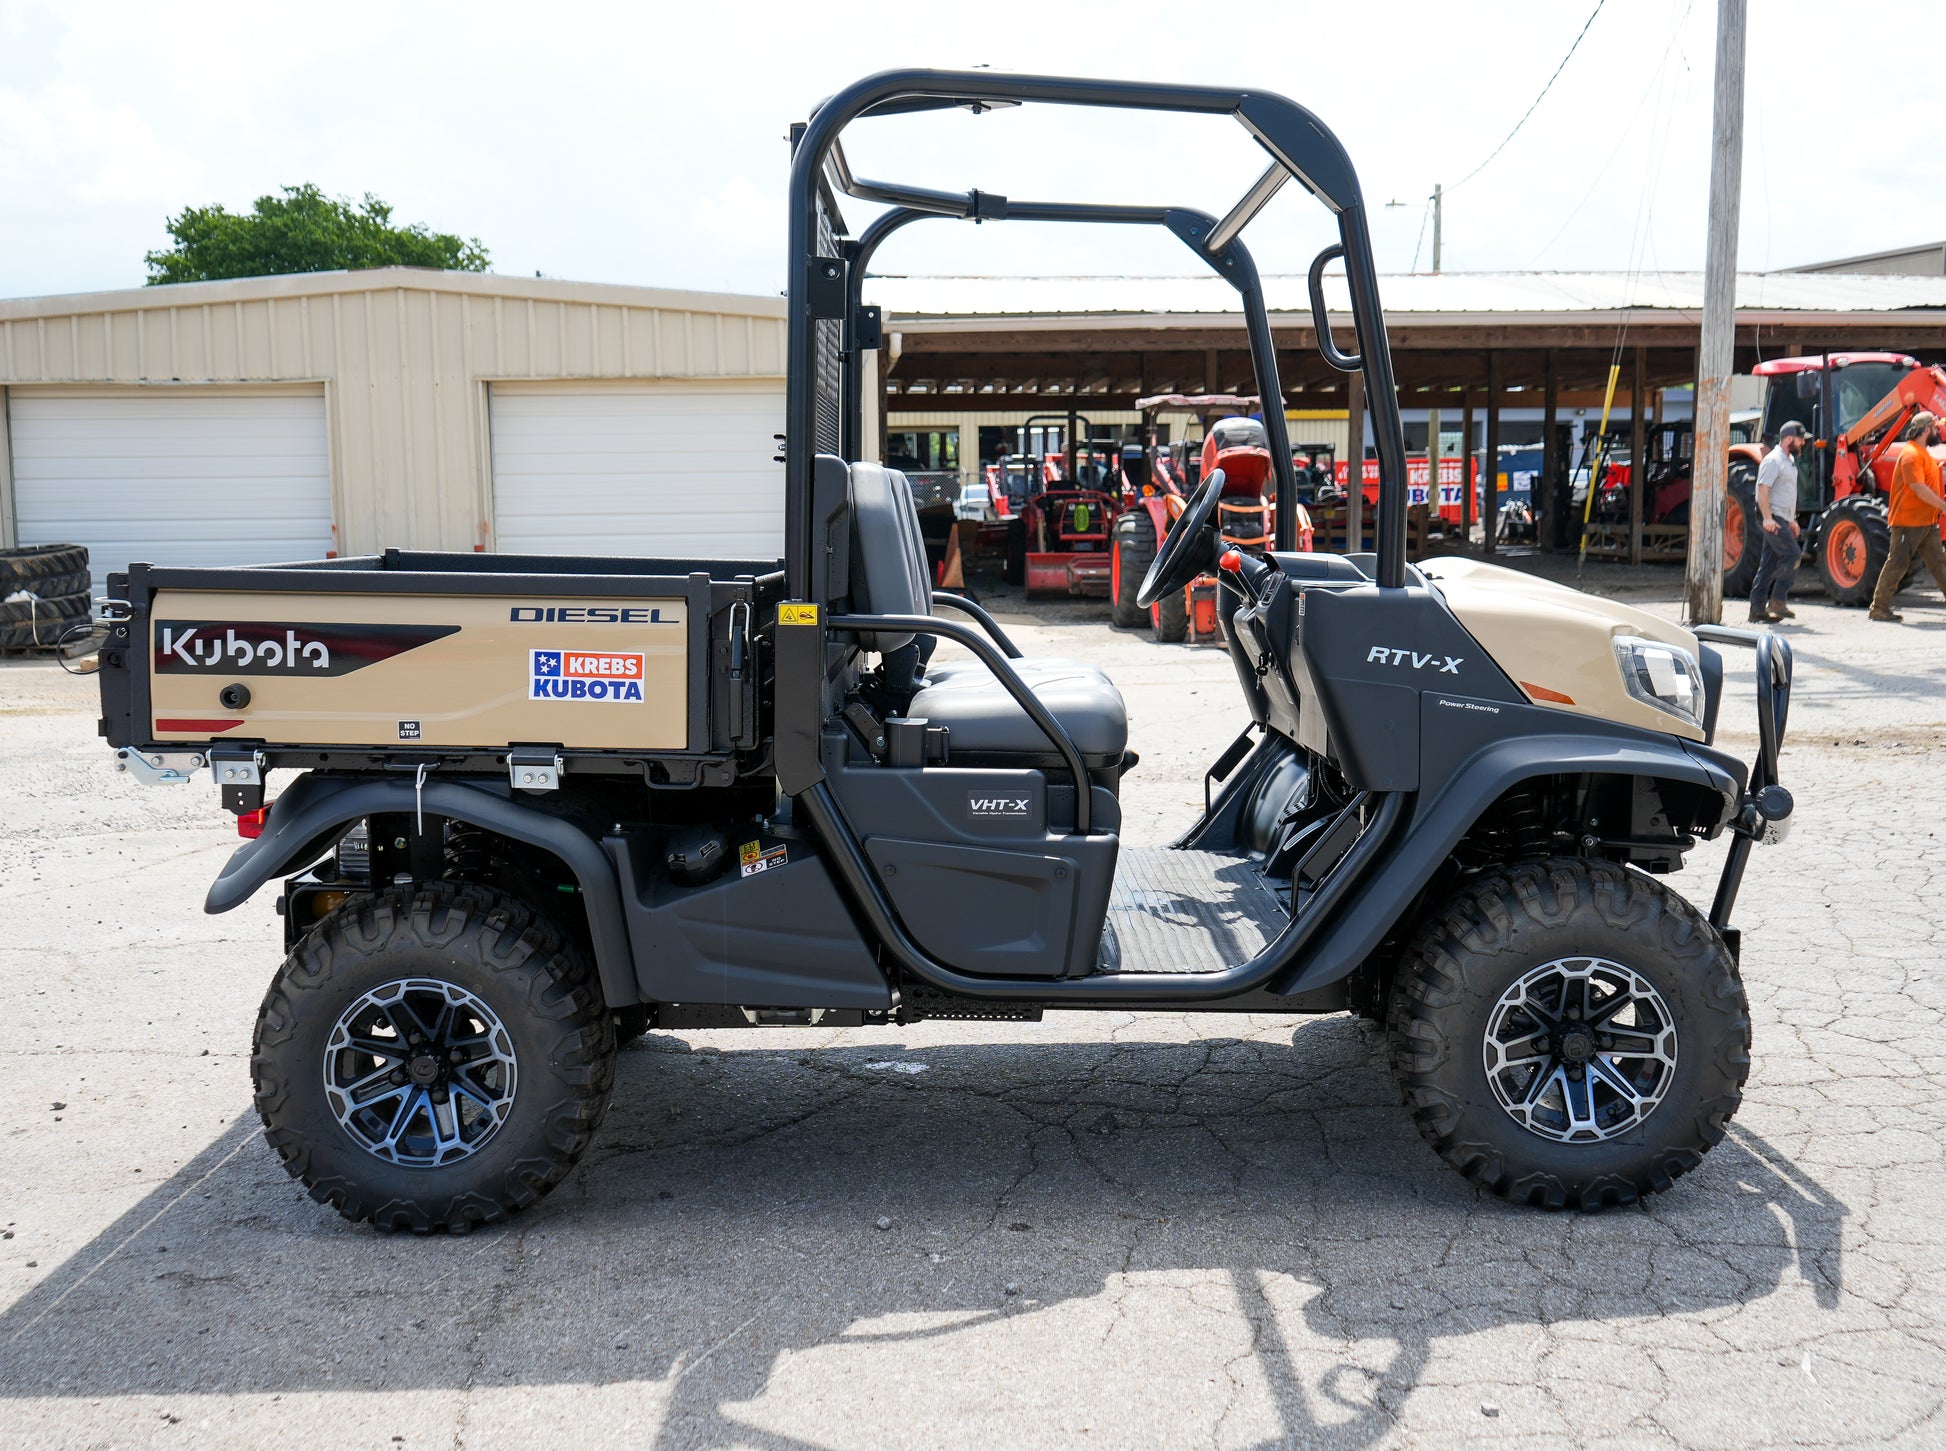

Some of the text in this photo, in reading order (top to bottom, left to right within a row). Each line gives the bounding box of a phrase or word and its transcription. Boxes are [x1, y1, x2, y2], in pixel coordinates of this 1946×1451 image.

[510, 607, 680, 624] DIESEL
[163, 628, 330, 668] Kubota
[569, 656, 638, 676] KREBS
[1366, 646, 1464, 675] RTV-X
[533, 678, 643, 701] KUBOTA
[1439, 699, 1500, 714] Power Steering
[970, 799, 1030, 811] VHT-X
